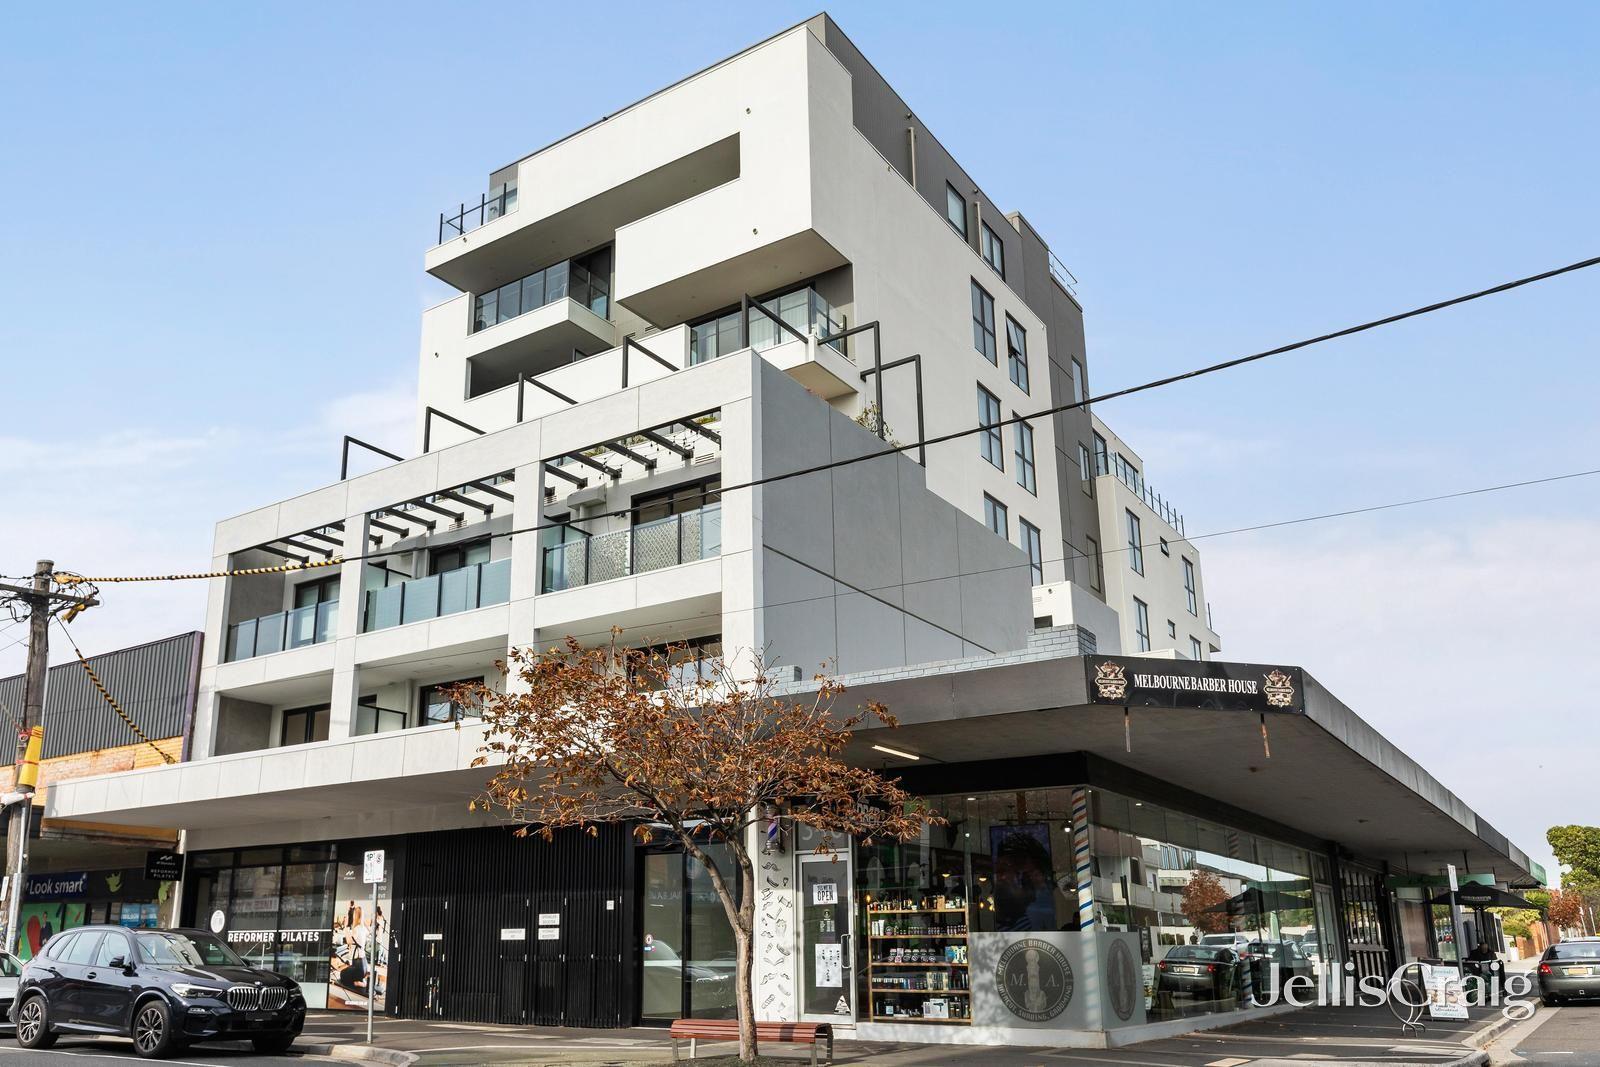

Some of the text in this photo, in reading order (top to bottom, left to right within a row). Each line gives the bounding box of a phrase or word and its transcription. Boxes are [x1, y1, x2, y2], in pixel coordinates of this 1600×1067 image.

[1133, 673, 1258, 695] MELBOURNE BARBER HOUSE
[29, 878, 84, 895] Look smart
[817, 890, 834, 901] OPEN
[227, 931, 320, 943] REFORMER PILATES
[997, 940, 1072, 976] MELBOURNE BARBER HOUSE
[1010, 973, 1027, 986] M.
